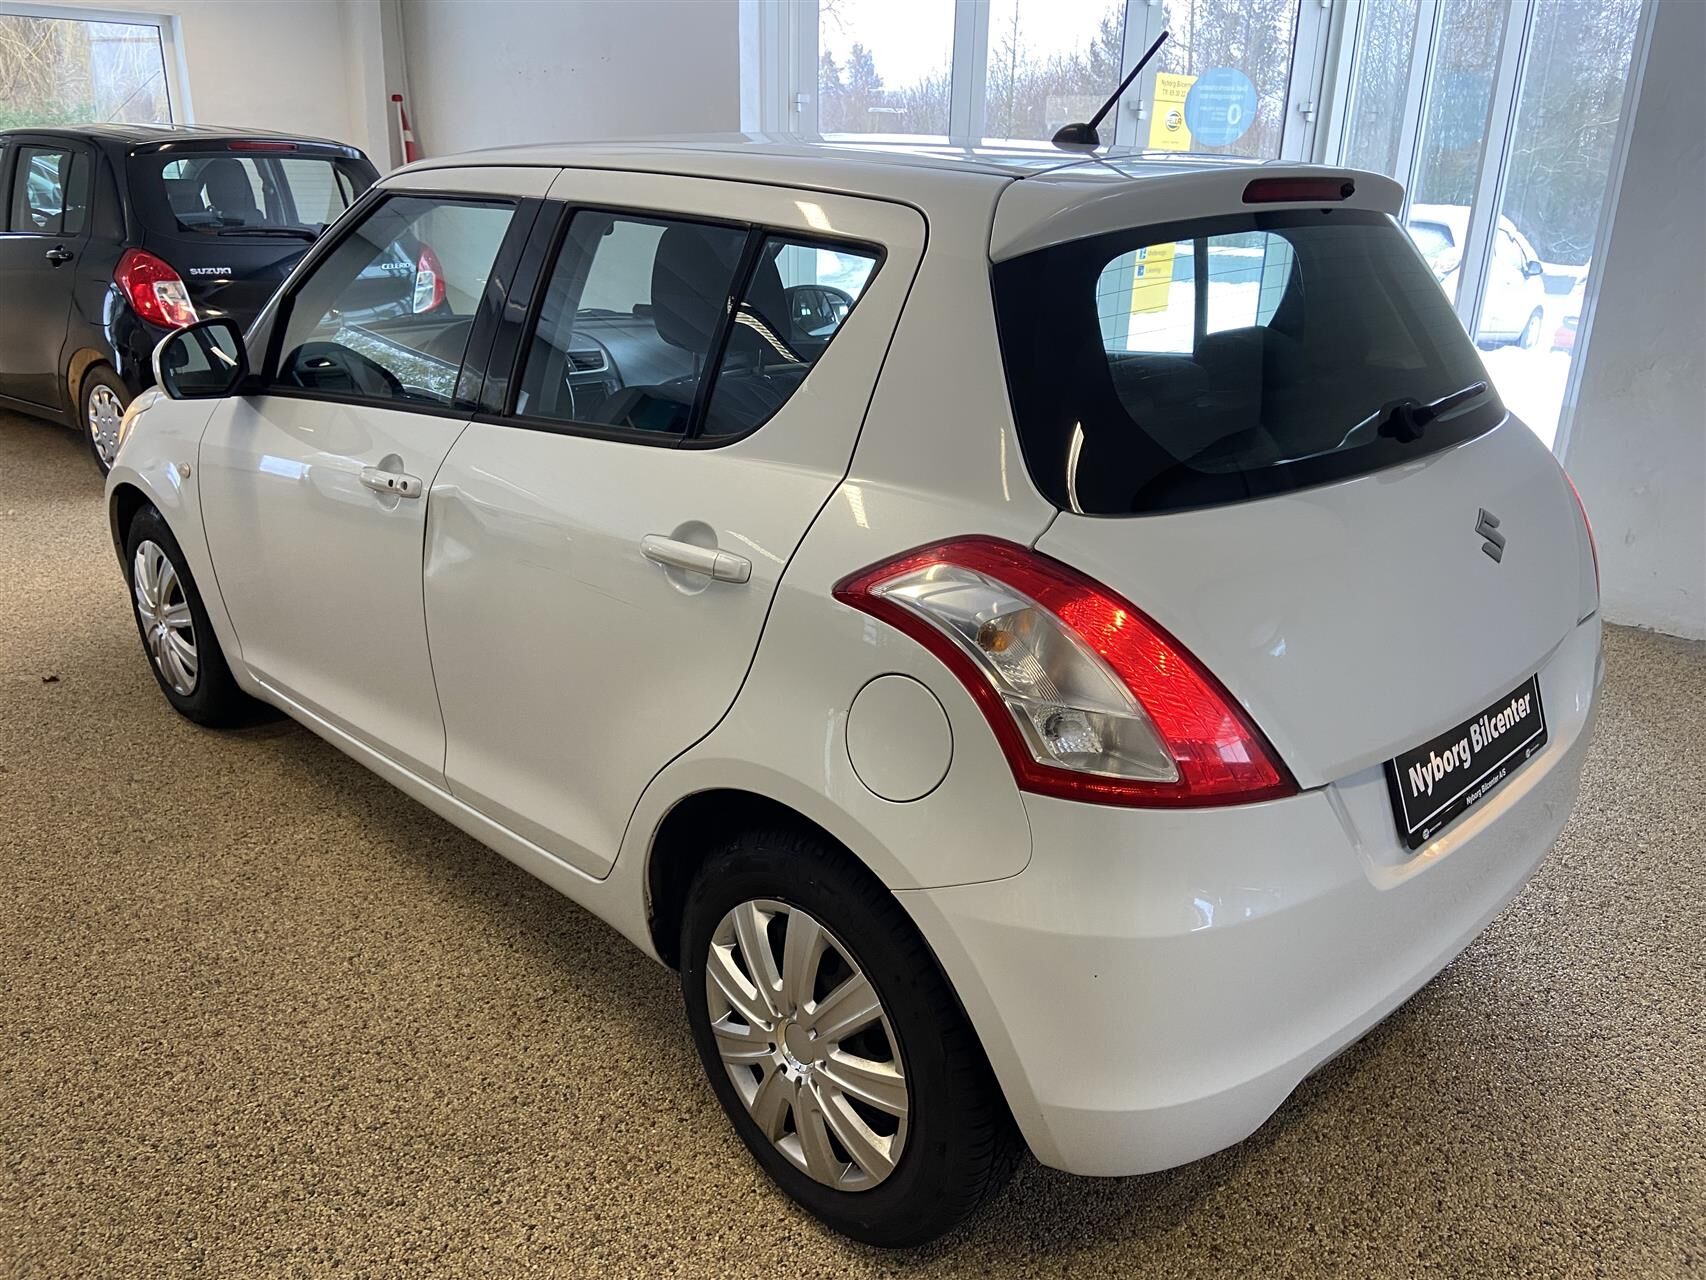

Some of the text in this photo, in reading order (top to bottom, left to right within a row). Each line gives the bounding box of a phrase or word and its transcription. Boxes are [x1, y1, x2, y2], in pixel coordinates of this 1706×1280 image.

[189, 267, 232, 275] SUZUKI
[1408, 693, 1530, 797] Nyborg Bilcenter
[1466, 767, 1507, 805] Nyborg Bilcenter A/S
